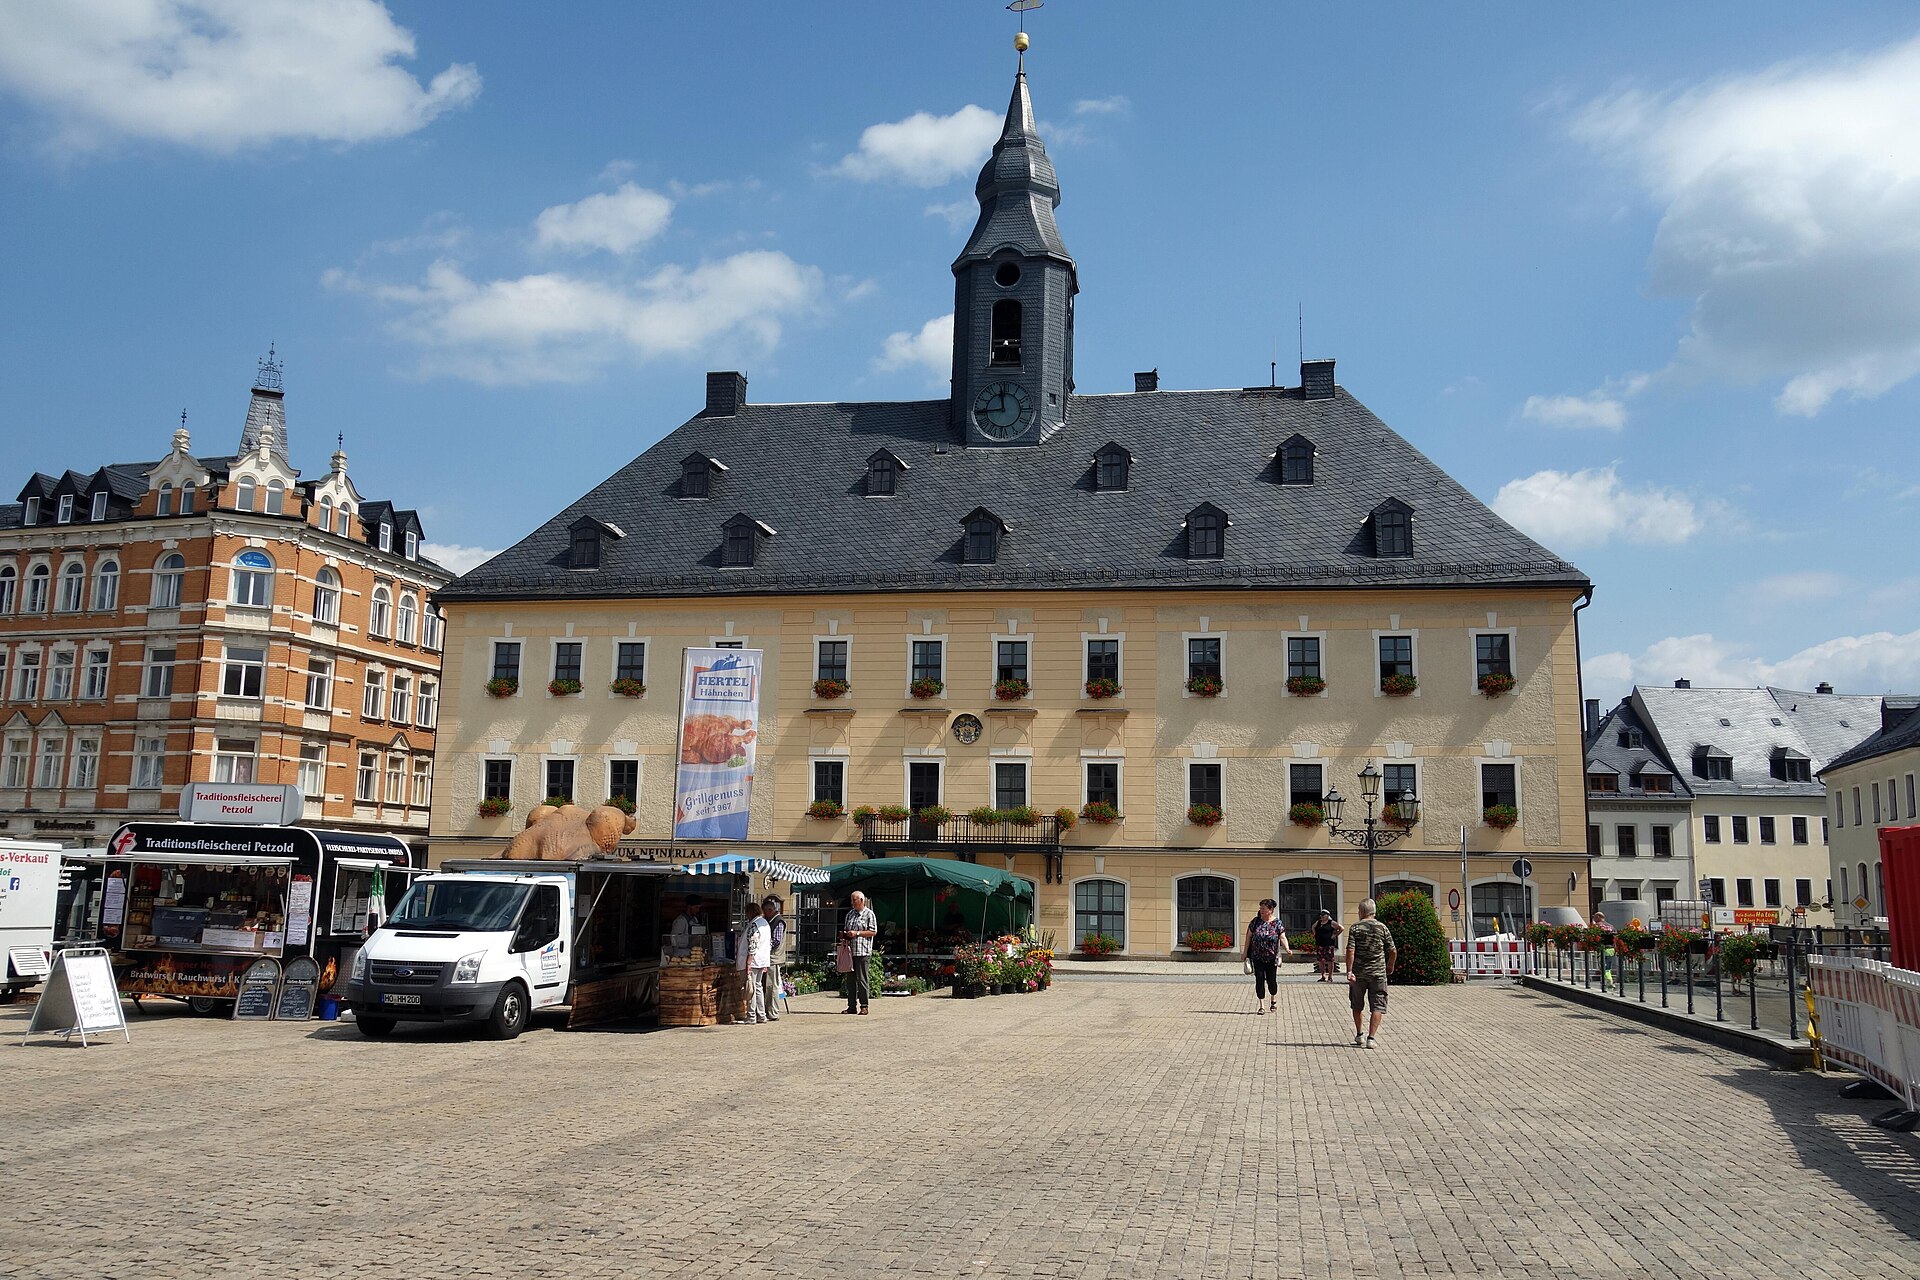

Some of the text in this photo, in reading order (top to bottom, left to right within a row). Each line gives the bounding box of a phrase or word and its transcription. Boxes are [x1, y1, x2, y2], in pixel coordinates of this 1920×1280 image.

[697, 676, 749, 687] HERTEL
[196, 792, 282, 803] Traditionsfleischerei
[685, 788, 744, 811] Grillgenuss
[221, 805, 253, 814] Petzold
[695, 802, 732, 817] seit 1967
[146, 837, 251, 852] Traditionsfleischerei
[254, 841, 294, 853] Petzold
[178, 972, 226, 984] Rauchwurst
[407, 996, 420, 1004] 200
